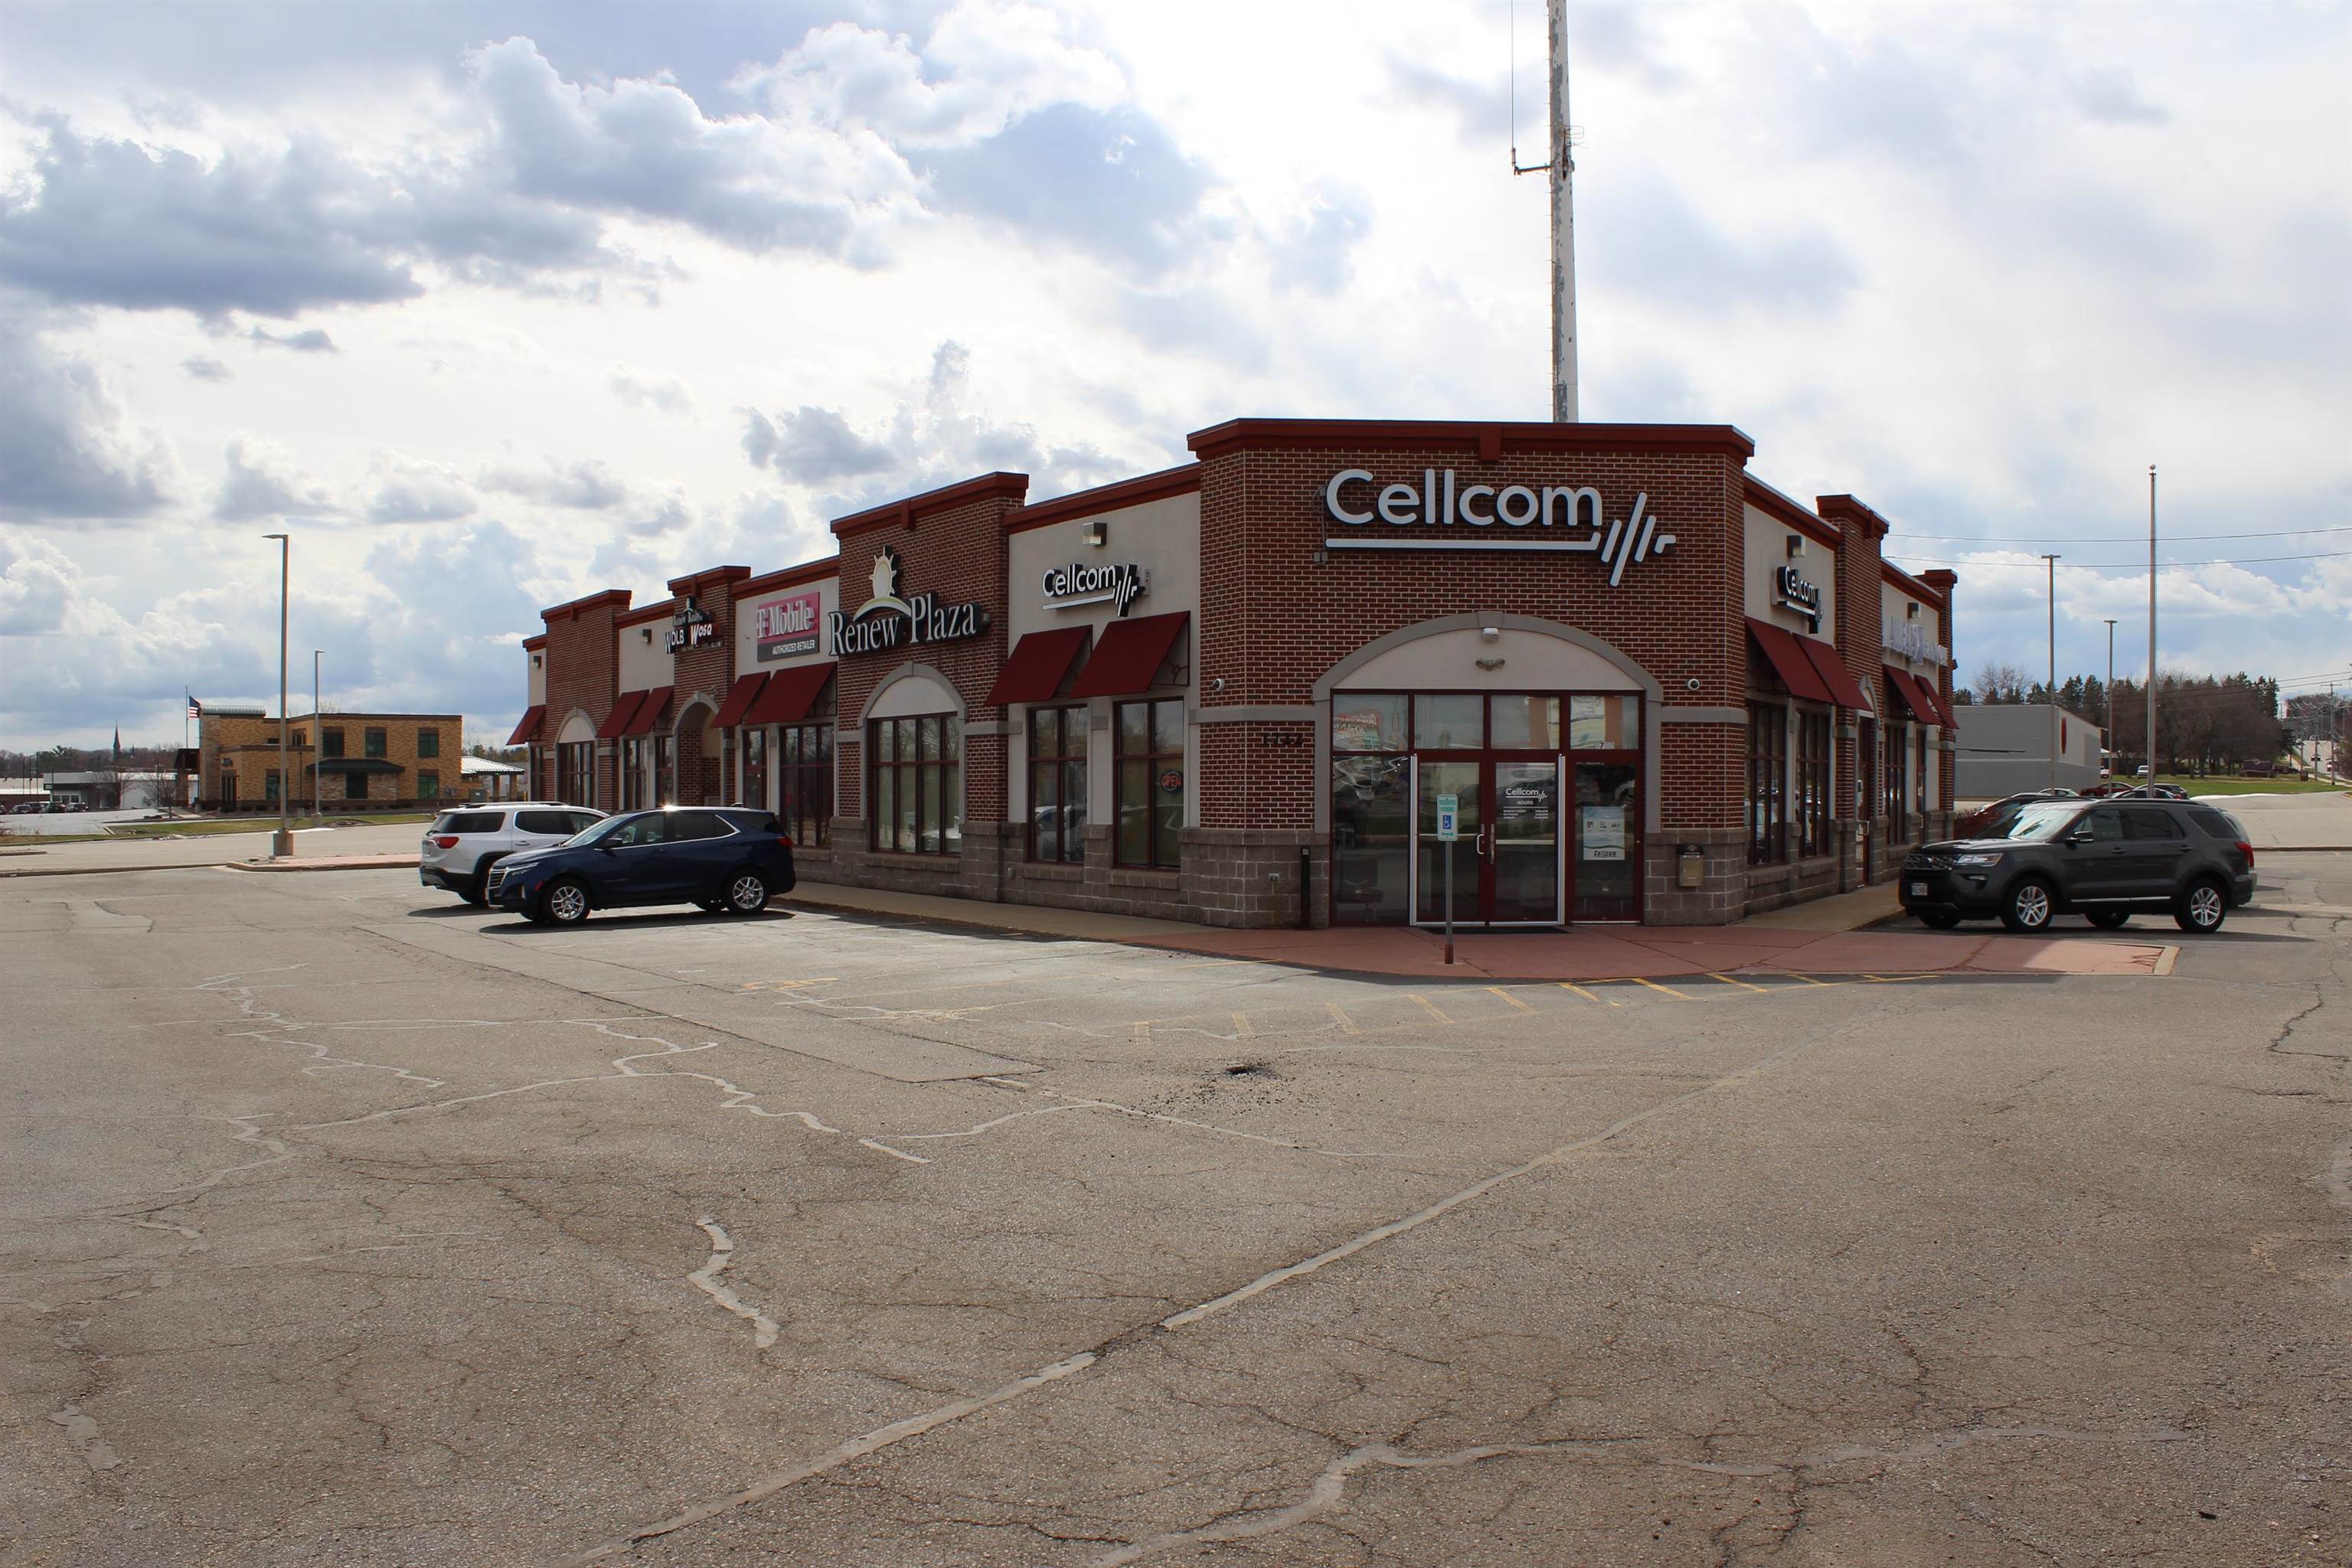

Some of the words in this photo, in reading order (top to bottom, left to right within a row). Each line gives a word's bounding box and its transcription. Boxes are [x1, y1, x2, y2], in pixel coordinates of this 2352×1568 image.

[1326, 468, 1603, 527] Cellcom
[1042, 563, 1118, 598] Cellcom
[756, 599, 815, 639] T-Mobile
[828, 611, 900, 657] Renew
[909, 592, 978, 645] Plaza
[1161, 774, 1181, 787] OPEN
